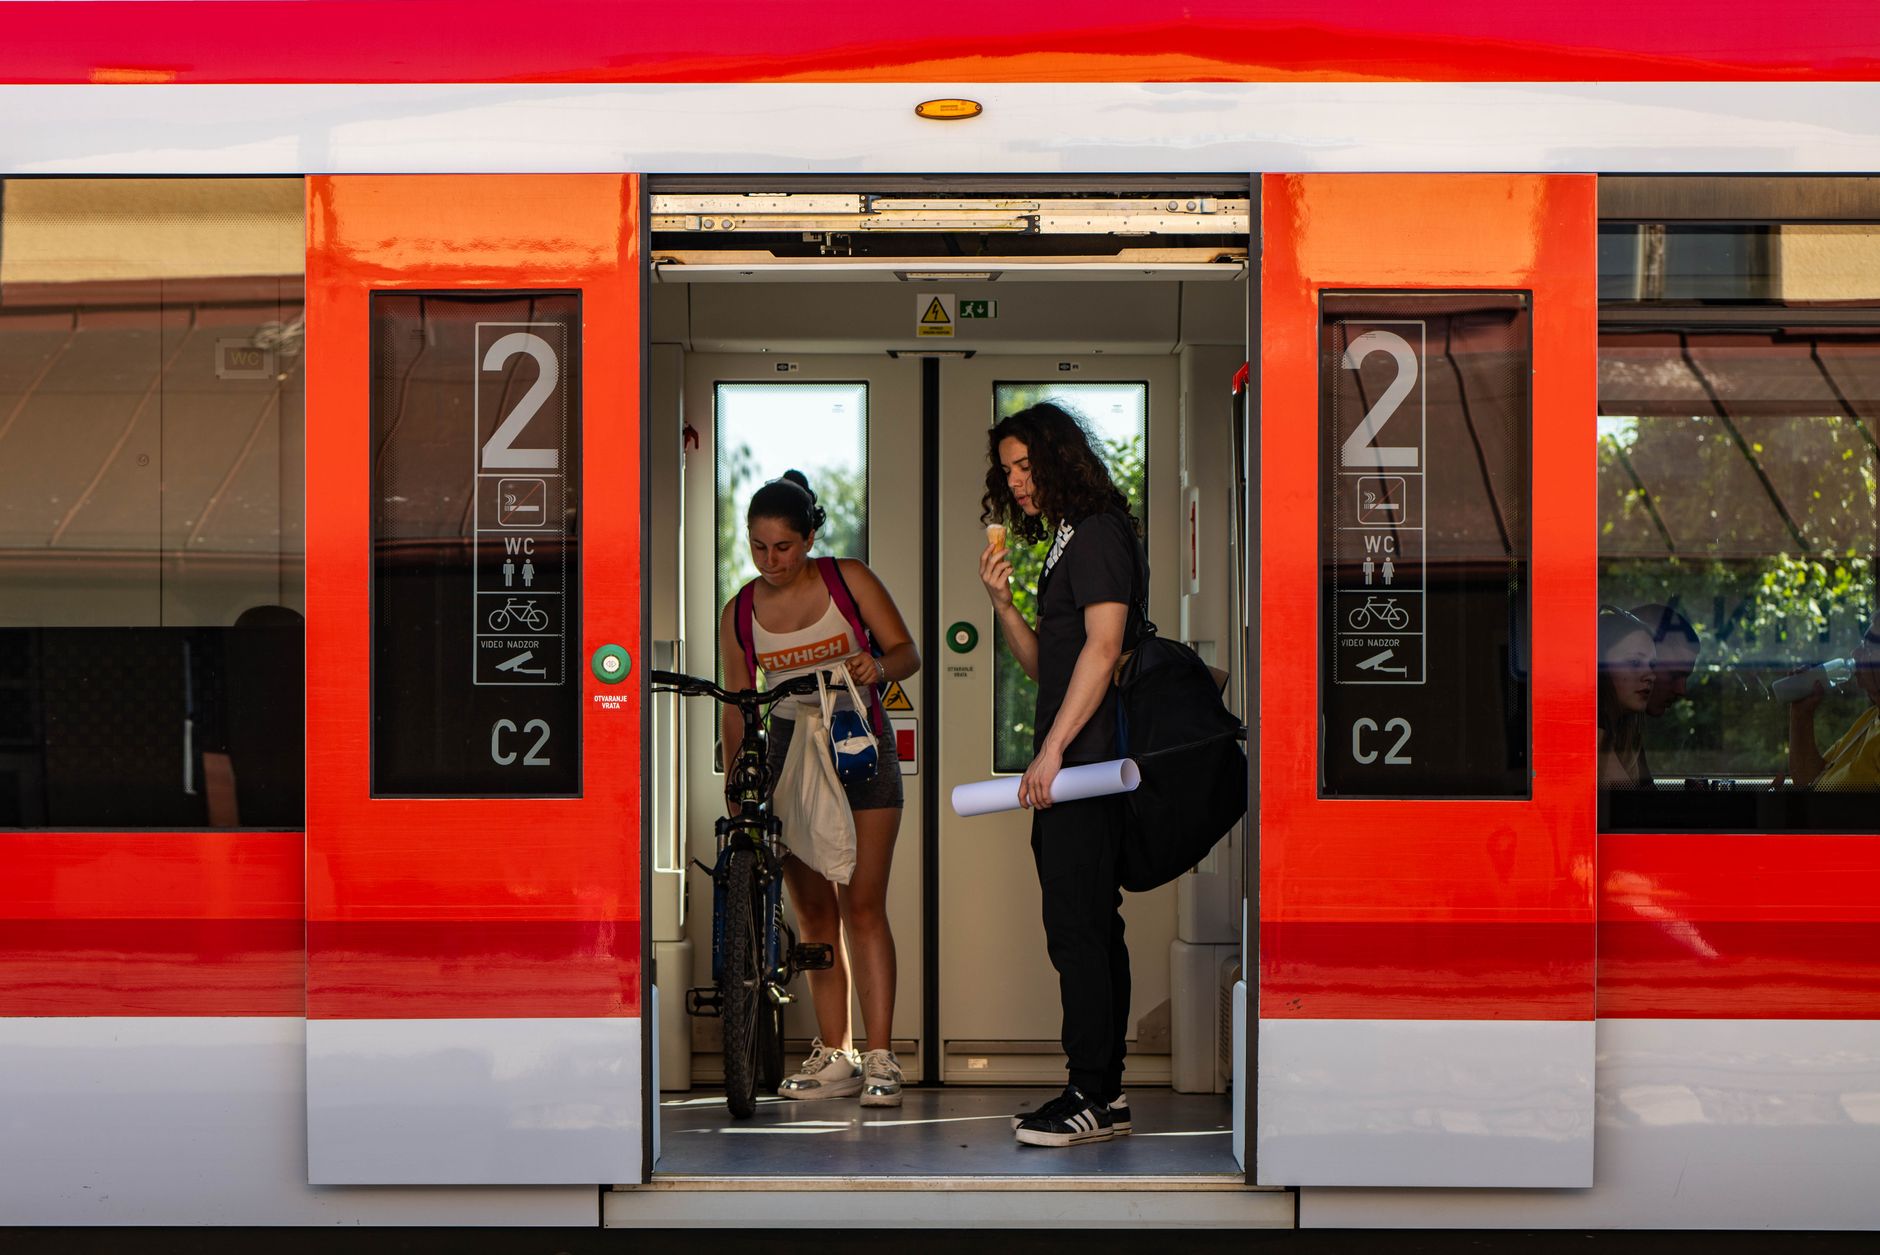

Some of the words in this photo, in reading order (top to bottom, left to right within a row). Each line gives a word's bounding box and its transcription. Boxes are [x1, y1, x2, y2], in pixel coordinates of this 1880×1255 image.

[231, 351, 259, 366] WC
[481, 332, 559, 469] 2
[1341, 330, 1419, 467] 2
[504, 537, 535, 555] WC
[1364, 535, 1395, 553] WC
[481, 640, 504, 649] VIDEO
[506, 640, 539, 649] NADZOR
[1341, 638, 1364, 647] VIDEO
[1367, 638, 1400, 647] NADZOR
[763, 640, 842, 670] FLYHIGH
[491, 719, 551, 766] C2
[1352, 717, 1412, 765] C2
